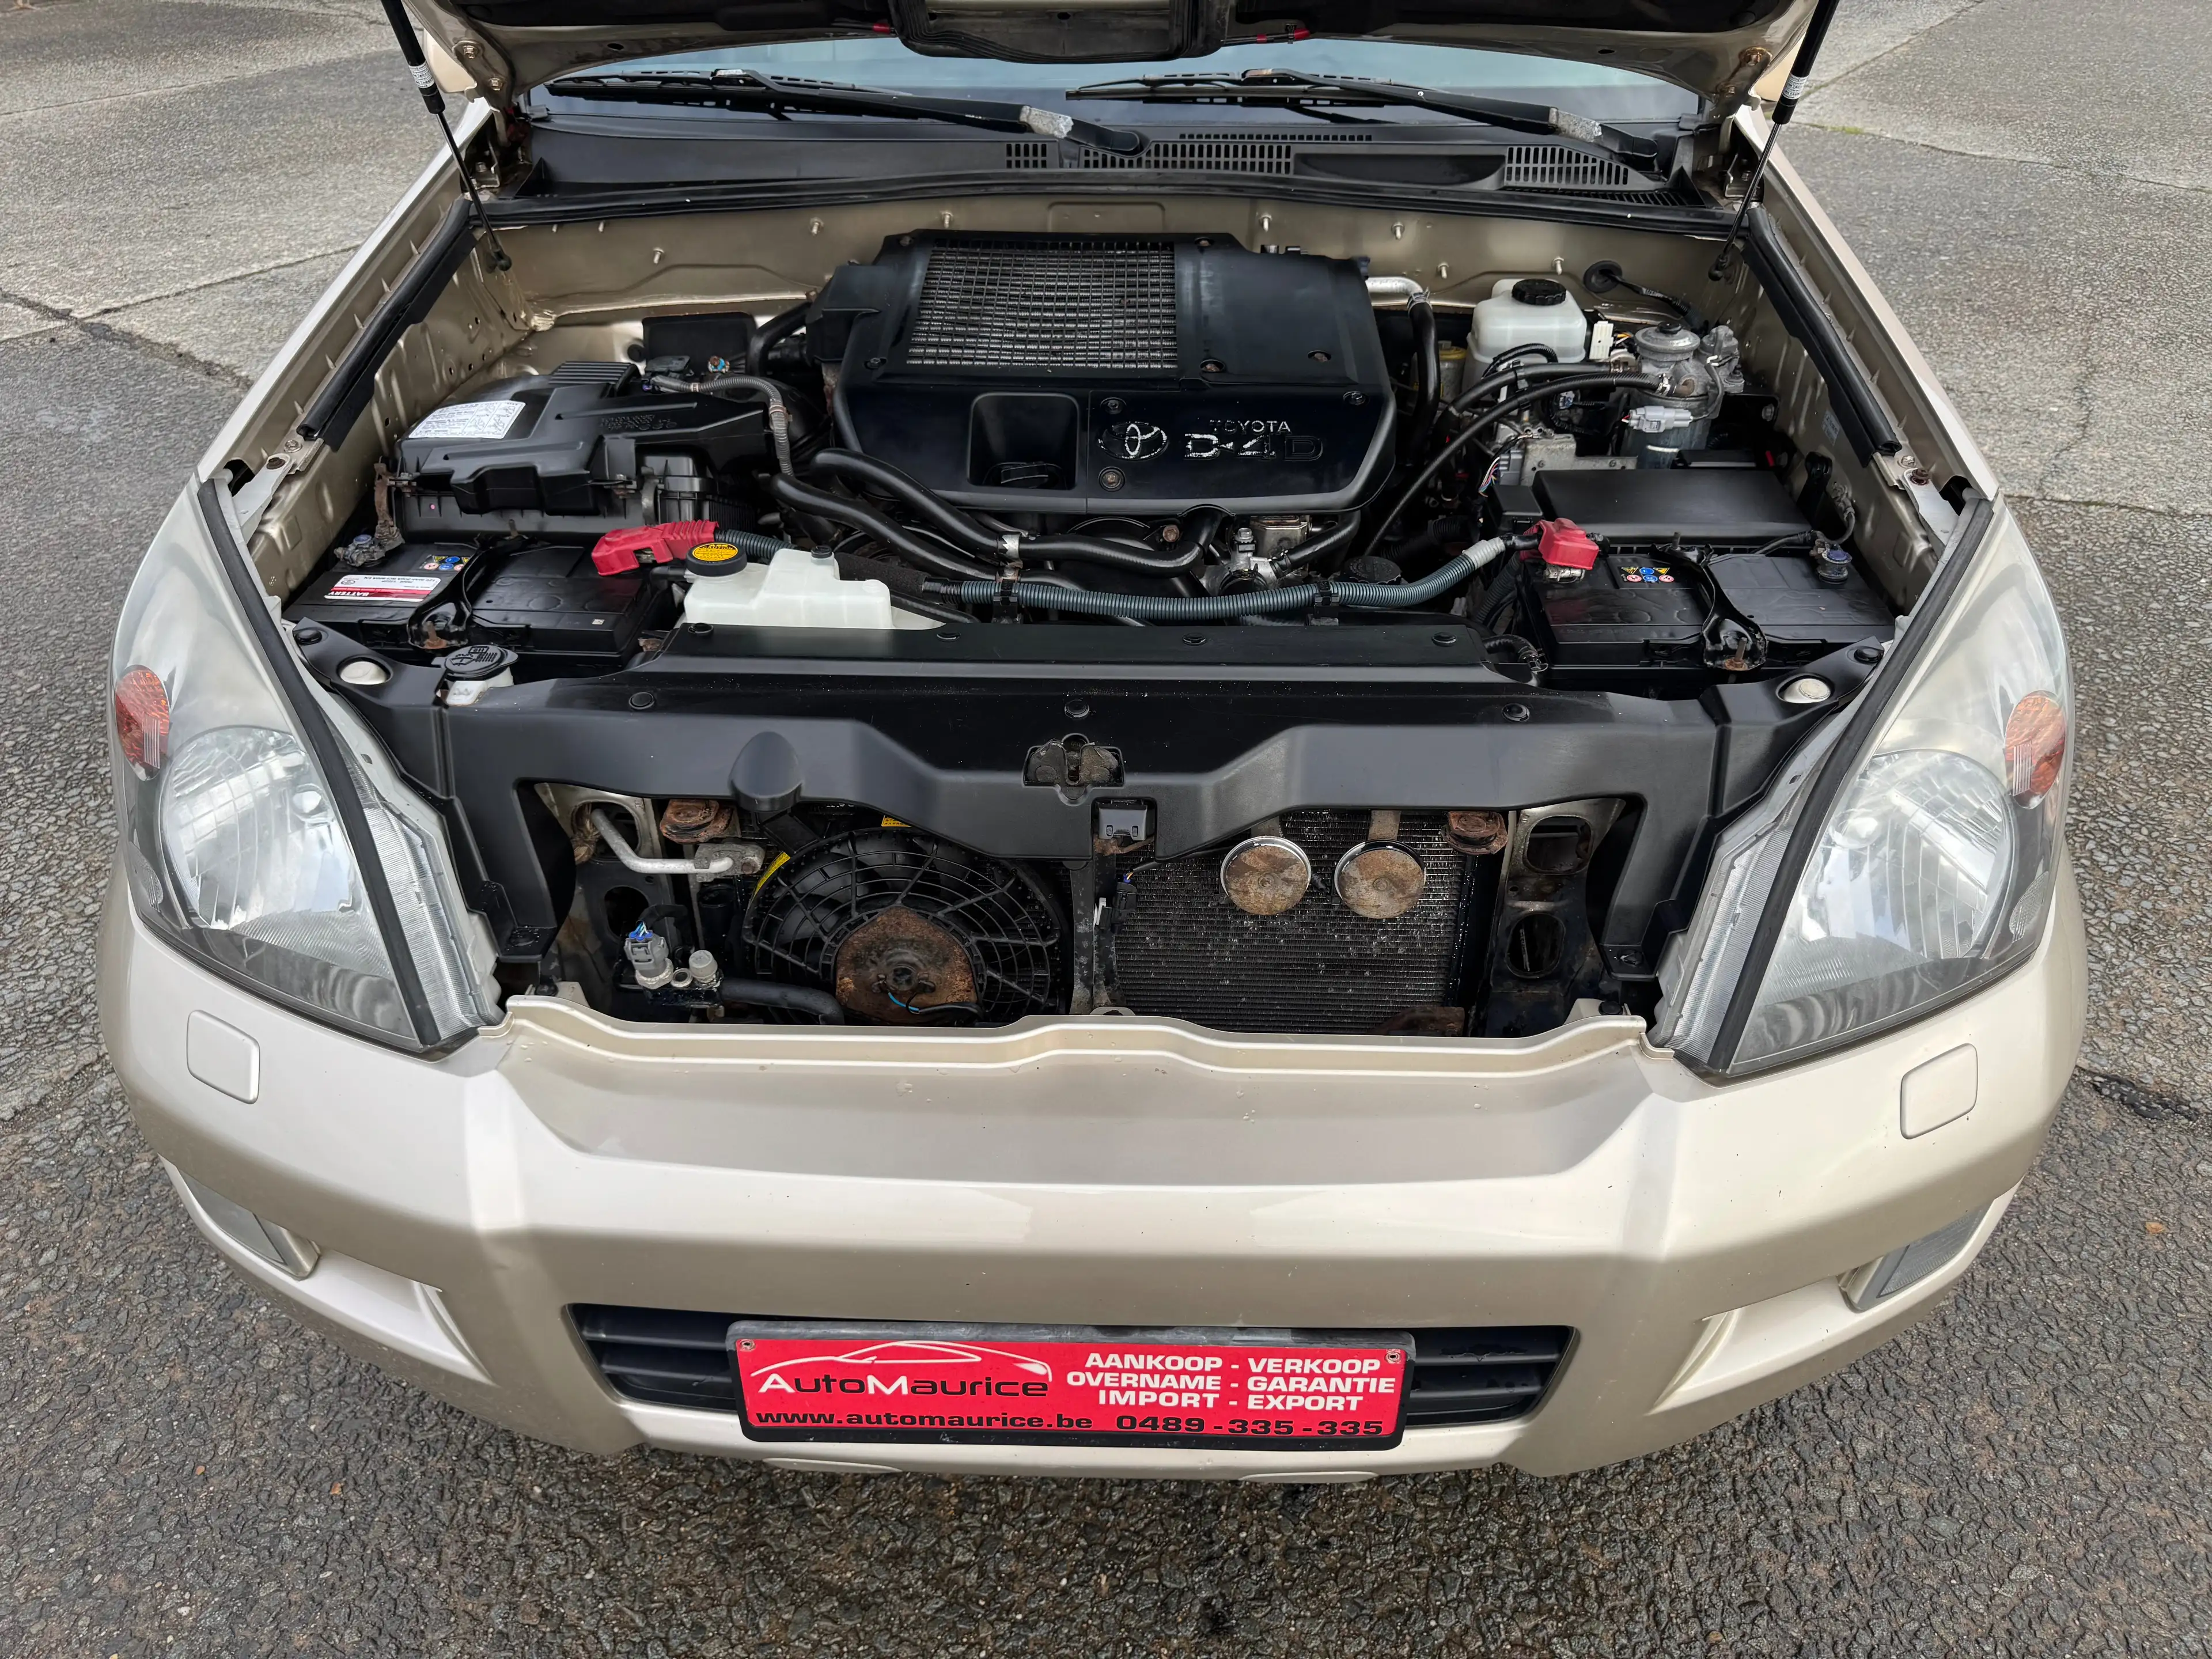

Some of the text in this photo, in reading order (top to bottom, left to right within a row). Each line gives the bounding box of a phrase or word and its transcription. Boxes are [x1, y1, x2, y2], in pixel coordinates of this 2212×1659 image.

[1210, 421, 1291, 433] TOYOTA
[1184, 433, 1323, 461] D-4D
[1085, 1353, 1222, 1372] AANKOOP
[1248, 1358, 1380, 1374] VERKOOP
[758, 1373, 1048, 1396] AutoMaurice
[1067, 1371, 1221, 1390] OVERNAME
[1247, 1376, 1396, 1393] GARANTIE
[1099, 1390, 1219, 1408] IMPORT
[1247, 1395, 1363, 1411] EXPORT
[756, 1412, 1092, 1428] www.automaurice.be
